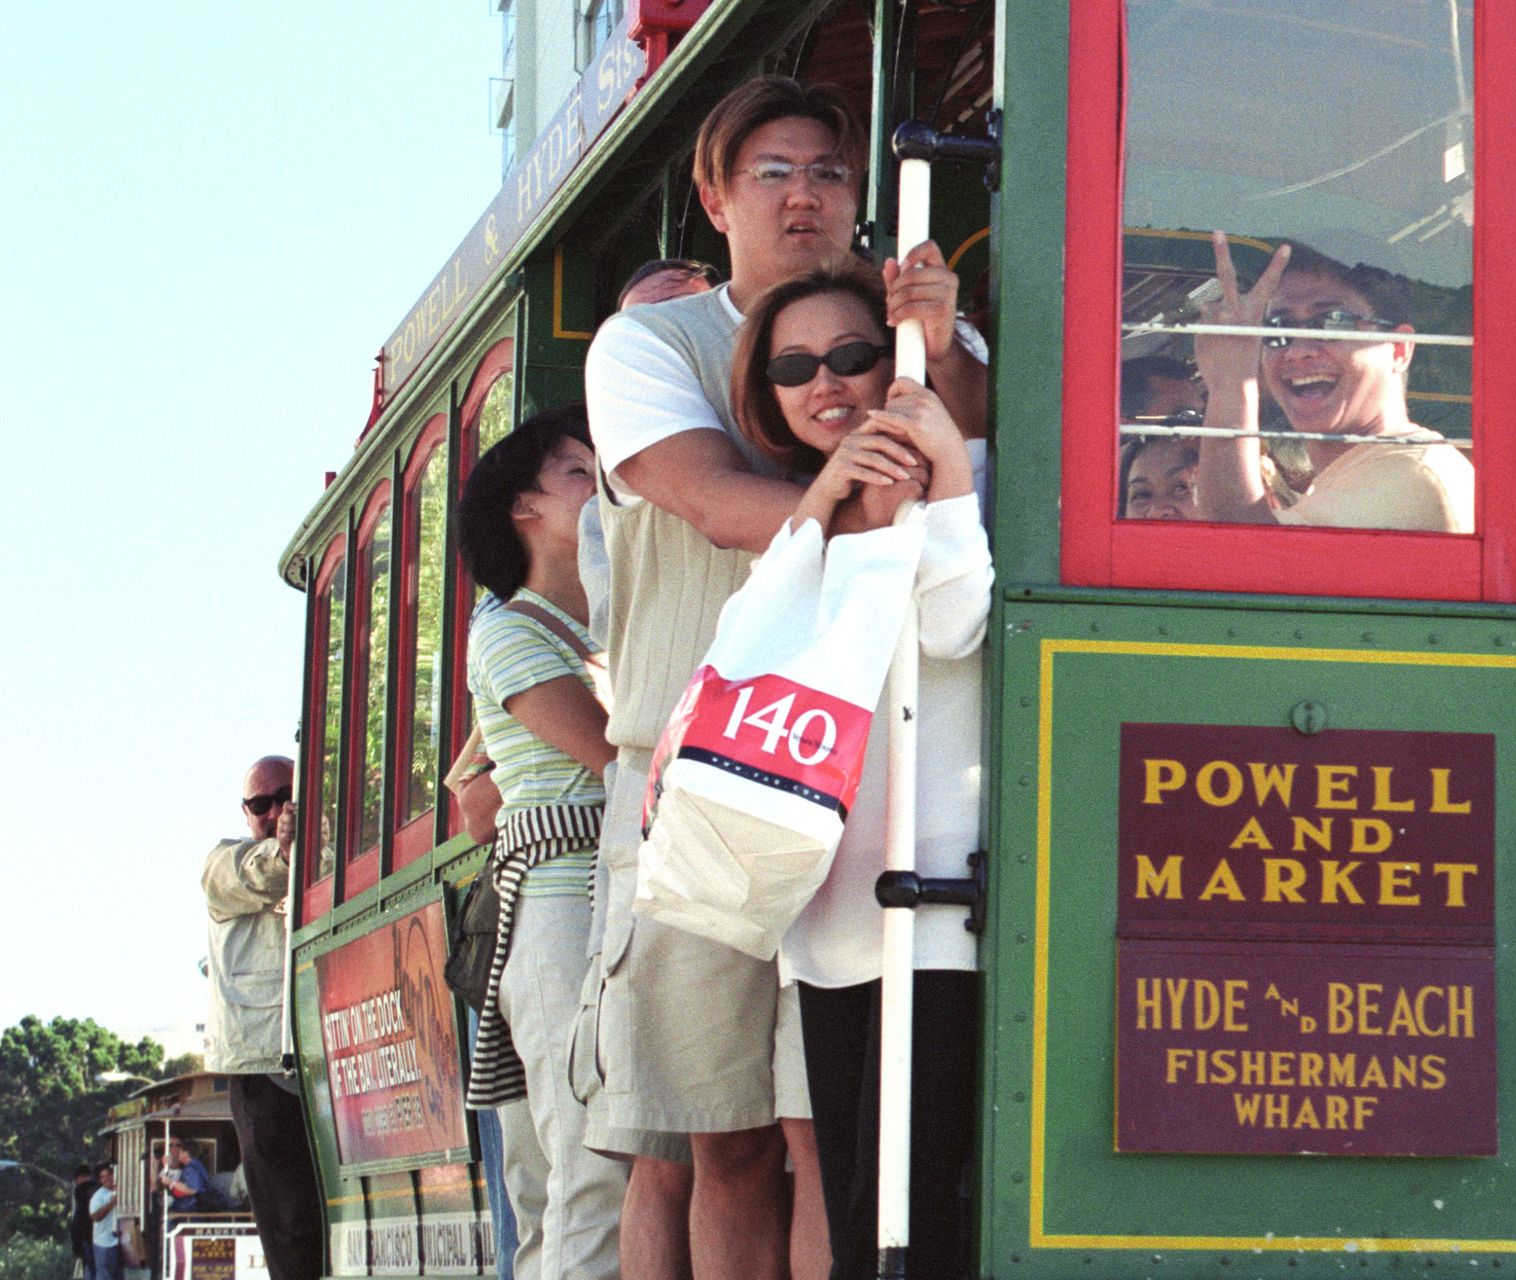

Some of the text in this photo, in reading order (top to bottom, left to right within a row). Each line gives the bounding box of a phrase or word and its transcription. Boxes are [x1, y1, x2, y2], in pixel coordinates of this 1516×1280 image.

[390, 255, 469, 385] POWELL
[484, 214, 499, 266] &
[516, 92, 584, 224] HYDE
[722, 686, 837, 766] 140
[1141, 758, 1472, 815] POWELL
[1229, 815, 1394, 854] AND
[1134, 854, 1479, 908] MARKET
[350, 1004, 364, 1046] ON
[361, 998, 378, 1041] THE
[376, 989, 405, 1038] DOCK
[1136, 977, 1475, 1038] HYDE AND BEACH
[341, 1055, 360, 1096] THE
[1165, 1048, 1448, 1090] FISHERMANS
[1233, 1092, 1380, 1130] WHARF
